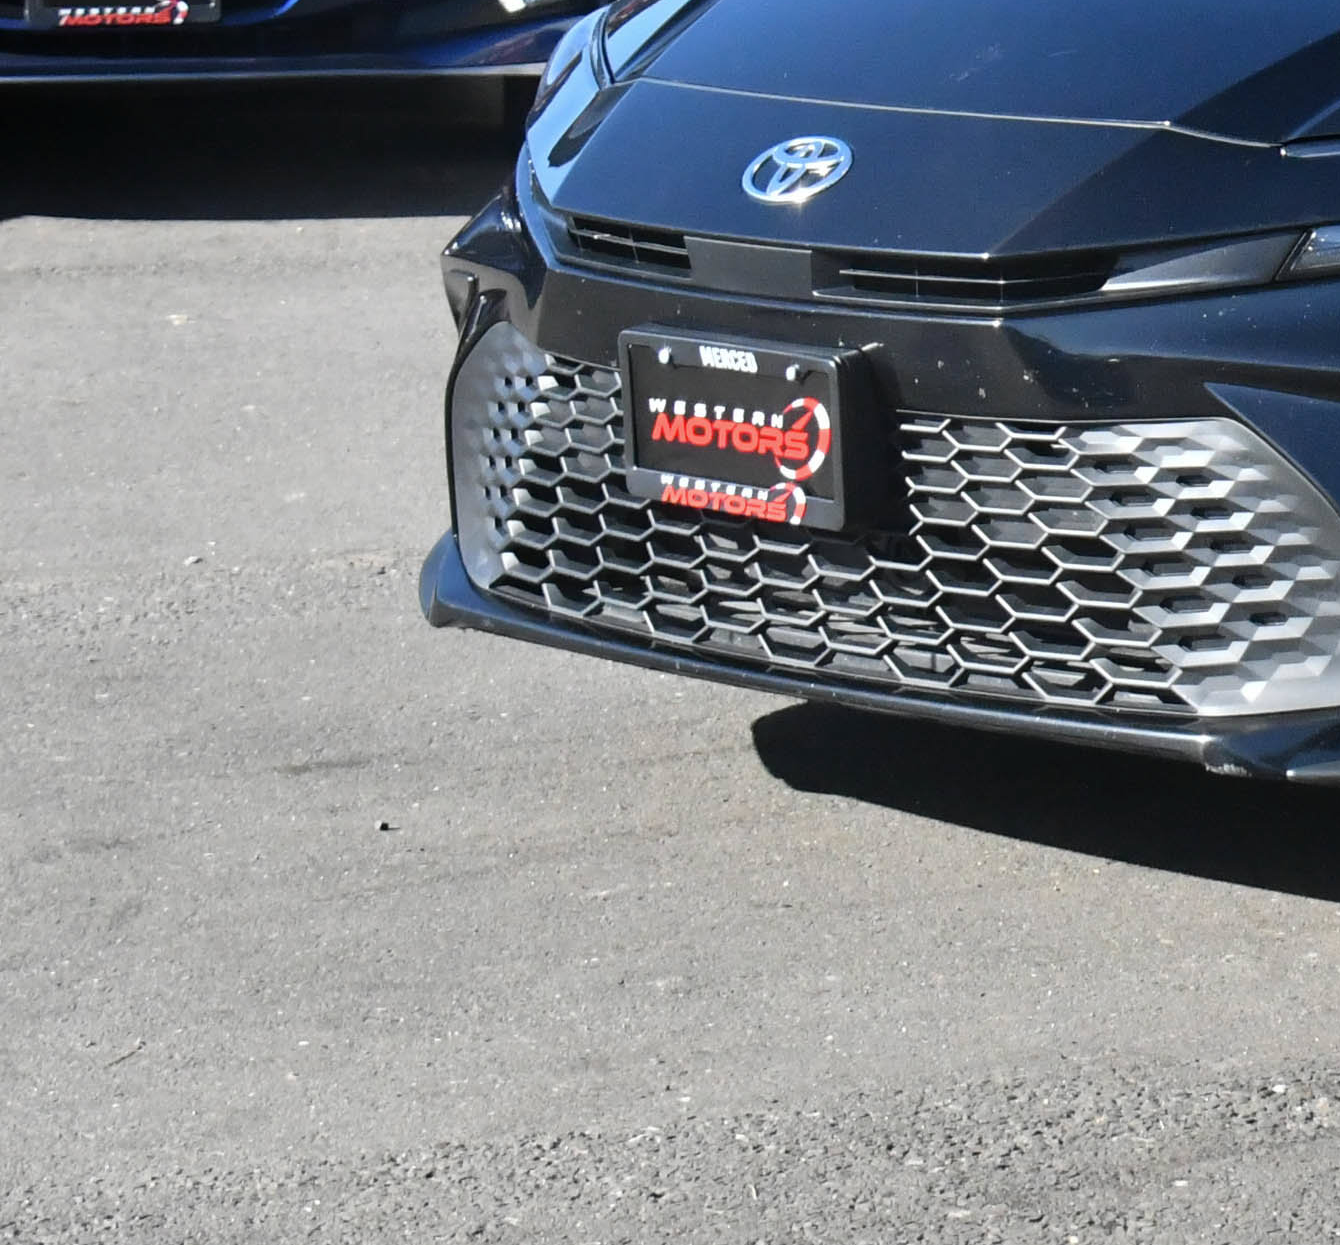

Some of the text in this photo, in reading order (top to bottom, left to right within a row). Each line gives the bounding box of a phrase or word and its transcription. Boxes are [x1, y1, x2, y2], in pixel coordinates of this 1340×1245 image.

[649, 398, 783, 428] WESTERN
[652, 413, 808, 460] MOTORS
[661, 474, 769, 501] WESTERN
[661, 486, 787, 523] MOTORS
